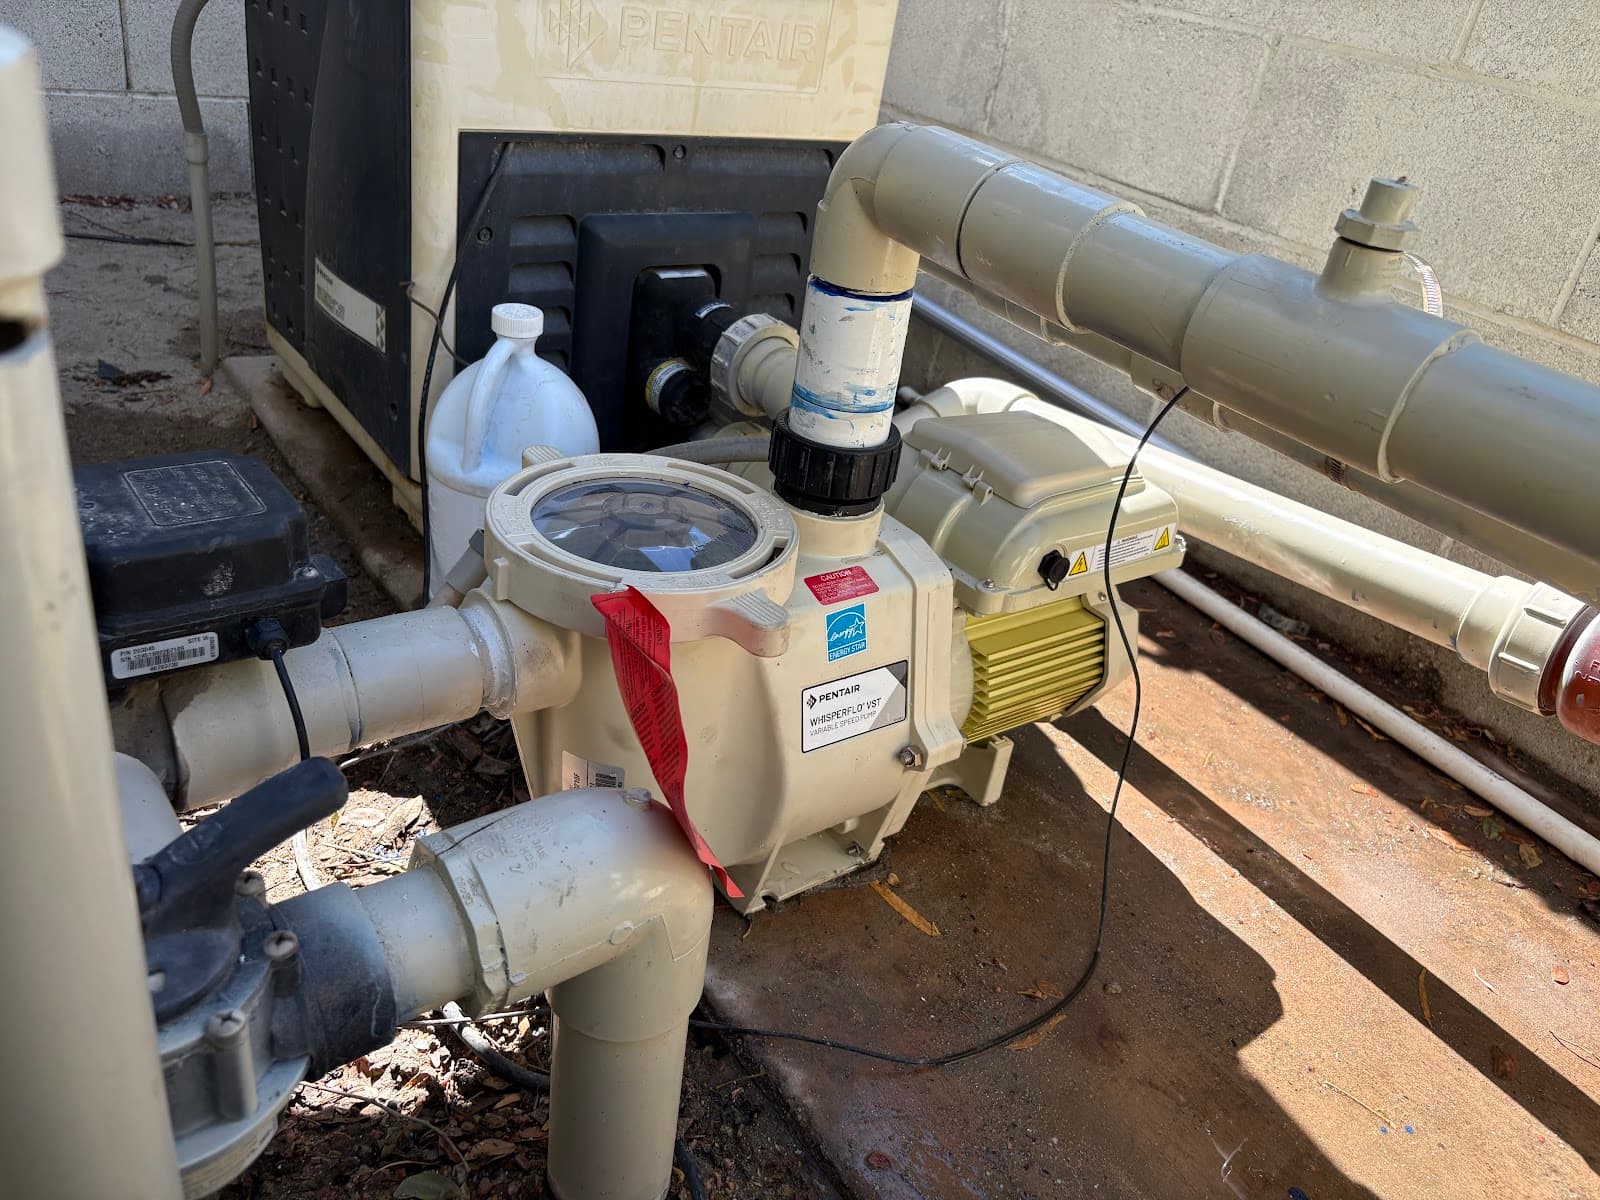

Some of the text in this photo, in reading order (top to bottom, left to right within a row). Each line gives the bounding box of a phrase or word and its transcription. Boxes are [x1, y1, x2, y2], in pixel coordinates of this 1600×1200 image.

[618, 6, 819, 63] PENTAIR
[820, 569, 852, 582] CAUTION
[829, 641, 866, 661] ENERGY STAR
[819, 684, 861, 704] PENTAIR
[866, 697, 883, 710] VST
[809, 720, 840, 737] VARIABLE
[839, 715, 861, 729] SPEED
[860, 709, 878, 723] PUMP
